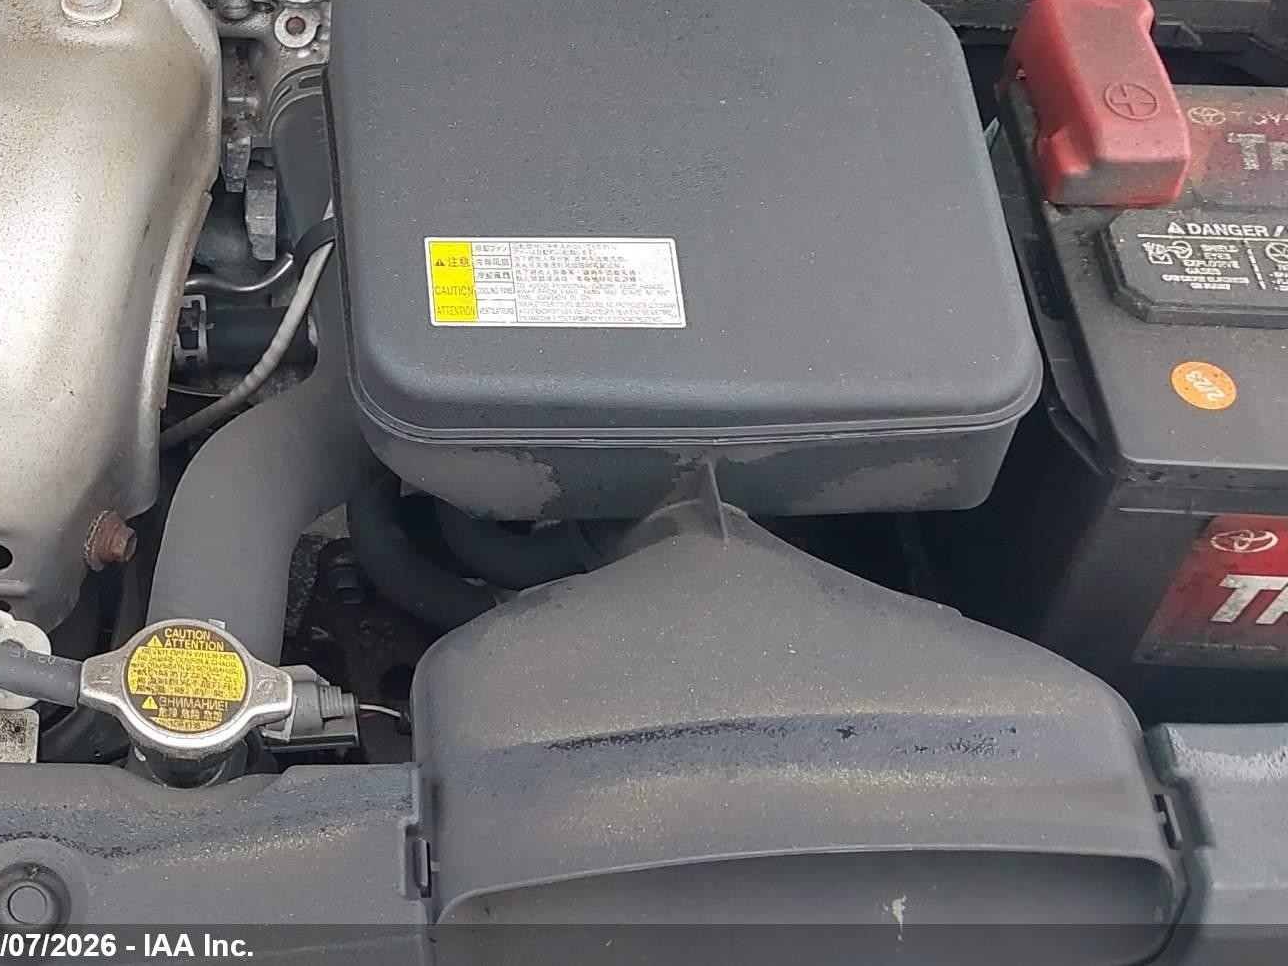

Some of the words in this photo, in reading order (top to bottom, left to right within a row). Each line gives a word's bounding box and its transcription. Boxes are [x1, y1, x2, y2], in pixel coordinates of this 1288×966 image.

[1185, 222, 1270, 237] DANGER
[434, 285, 474, 297] CAUTION
[436, 305, 476, 316] ATTENTION
[164, 628, 211, 641] CAUTION
[164, 638, 225, 652] ATTENTION
